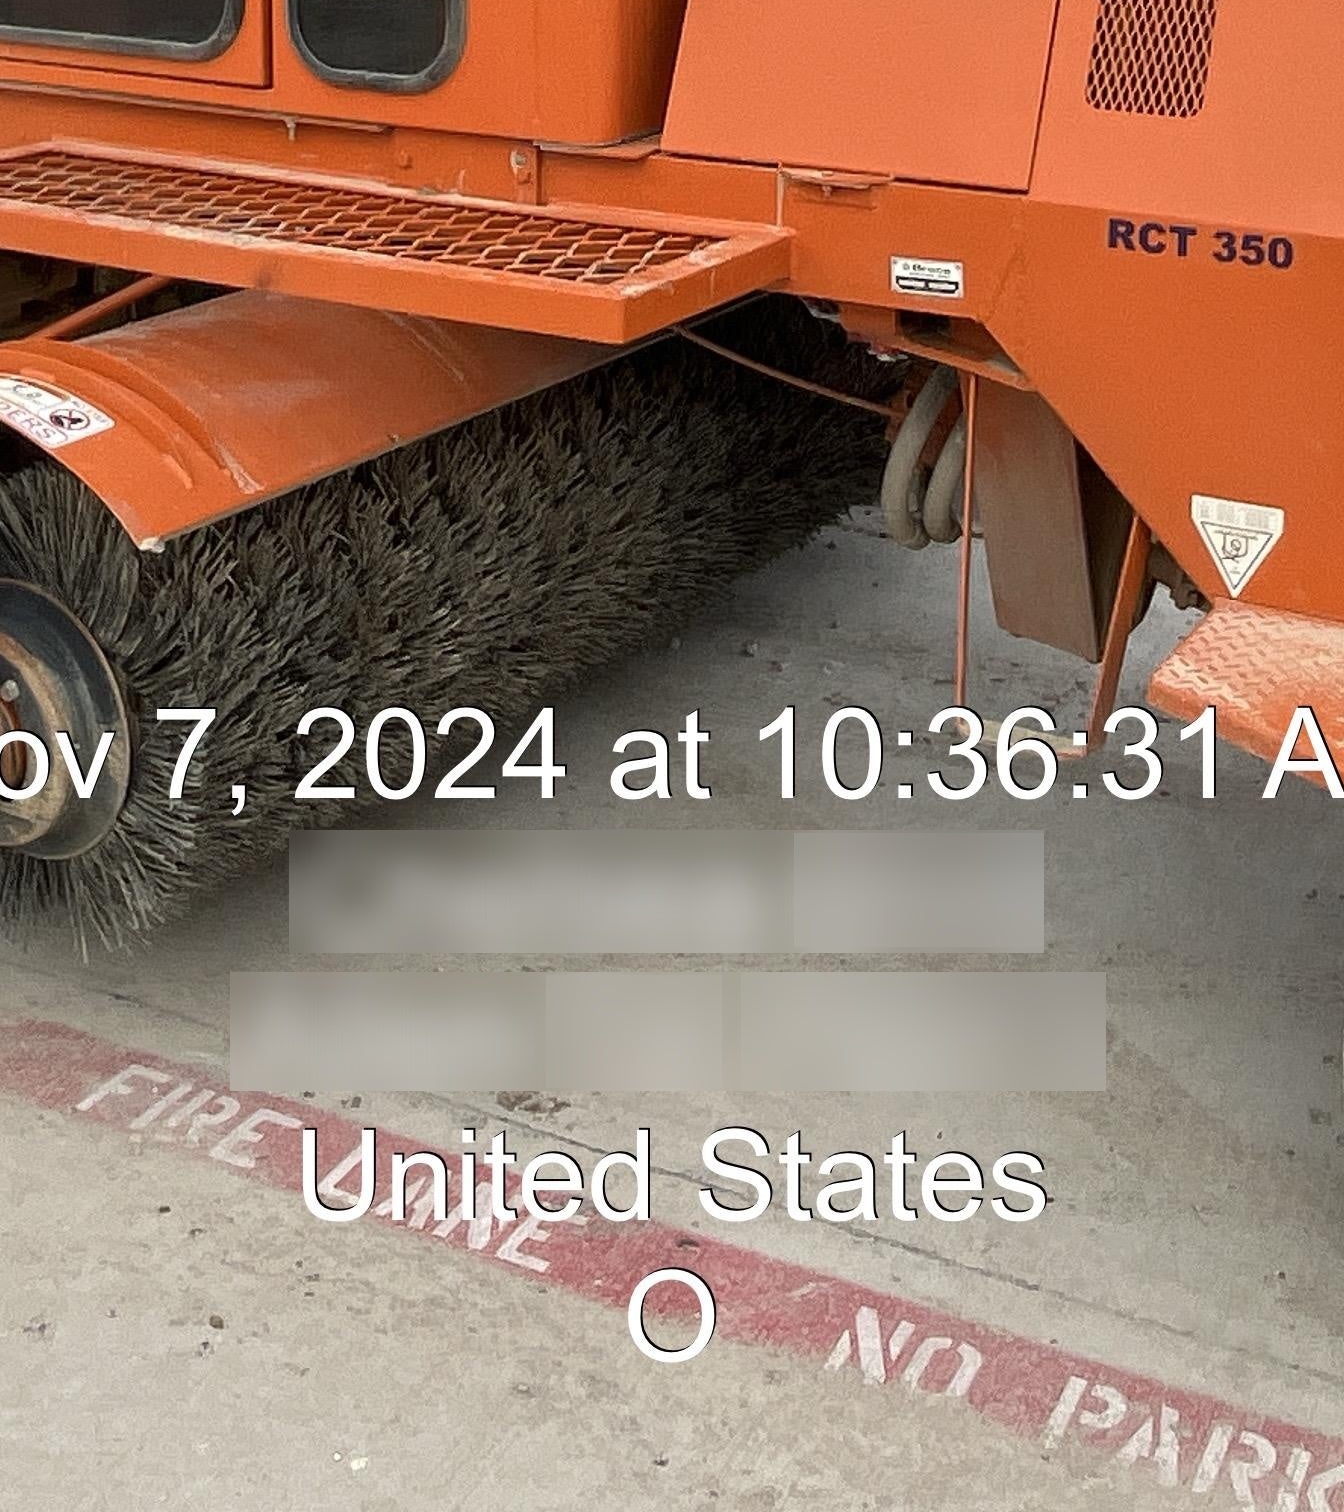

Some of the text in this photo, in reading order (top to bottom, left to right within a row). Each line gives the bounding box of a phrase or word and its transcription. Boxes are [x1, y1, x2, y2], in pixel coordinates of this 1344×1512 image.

[1108, 217, 1294, 270] RCT 350
[76, 1064, 304, 1170] FIRE
[822, 1304, 982, 1397] NO
